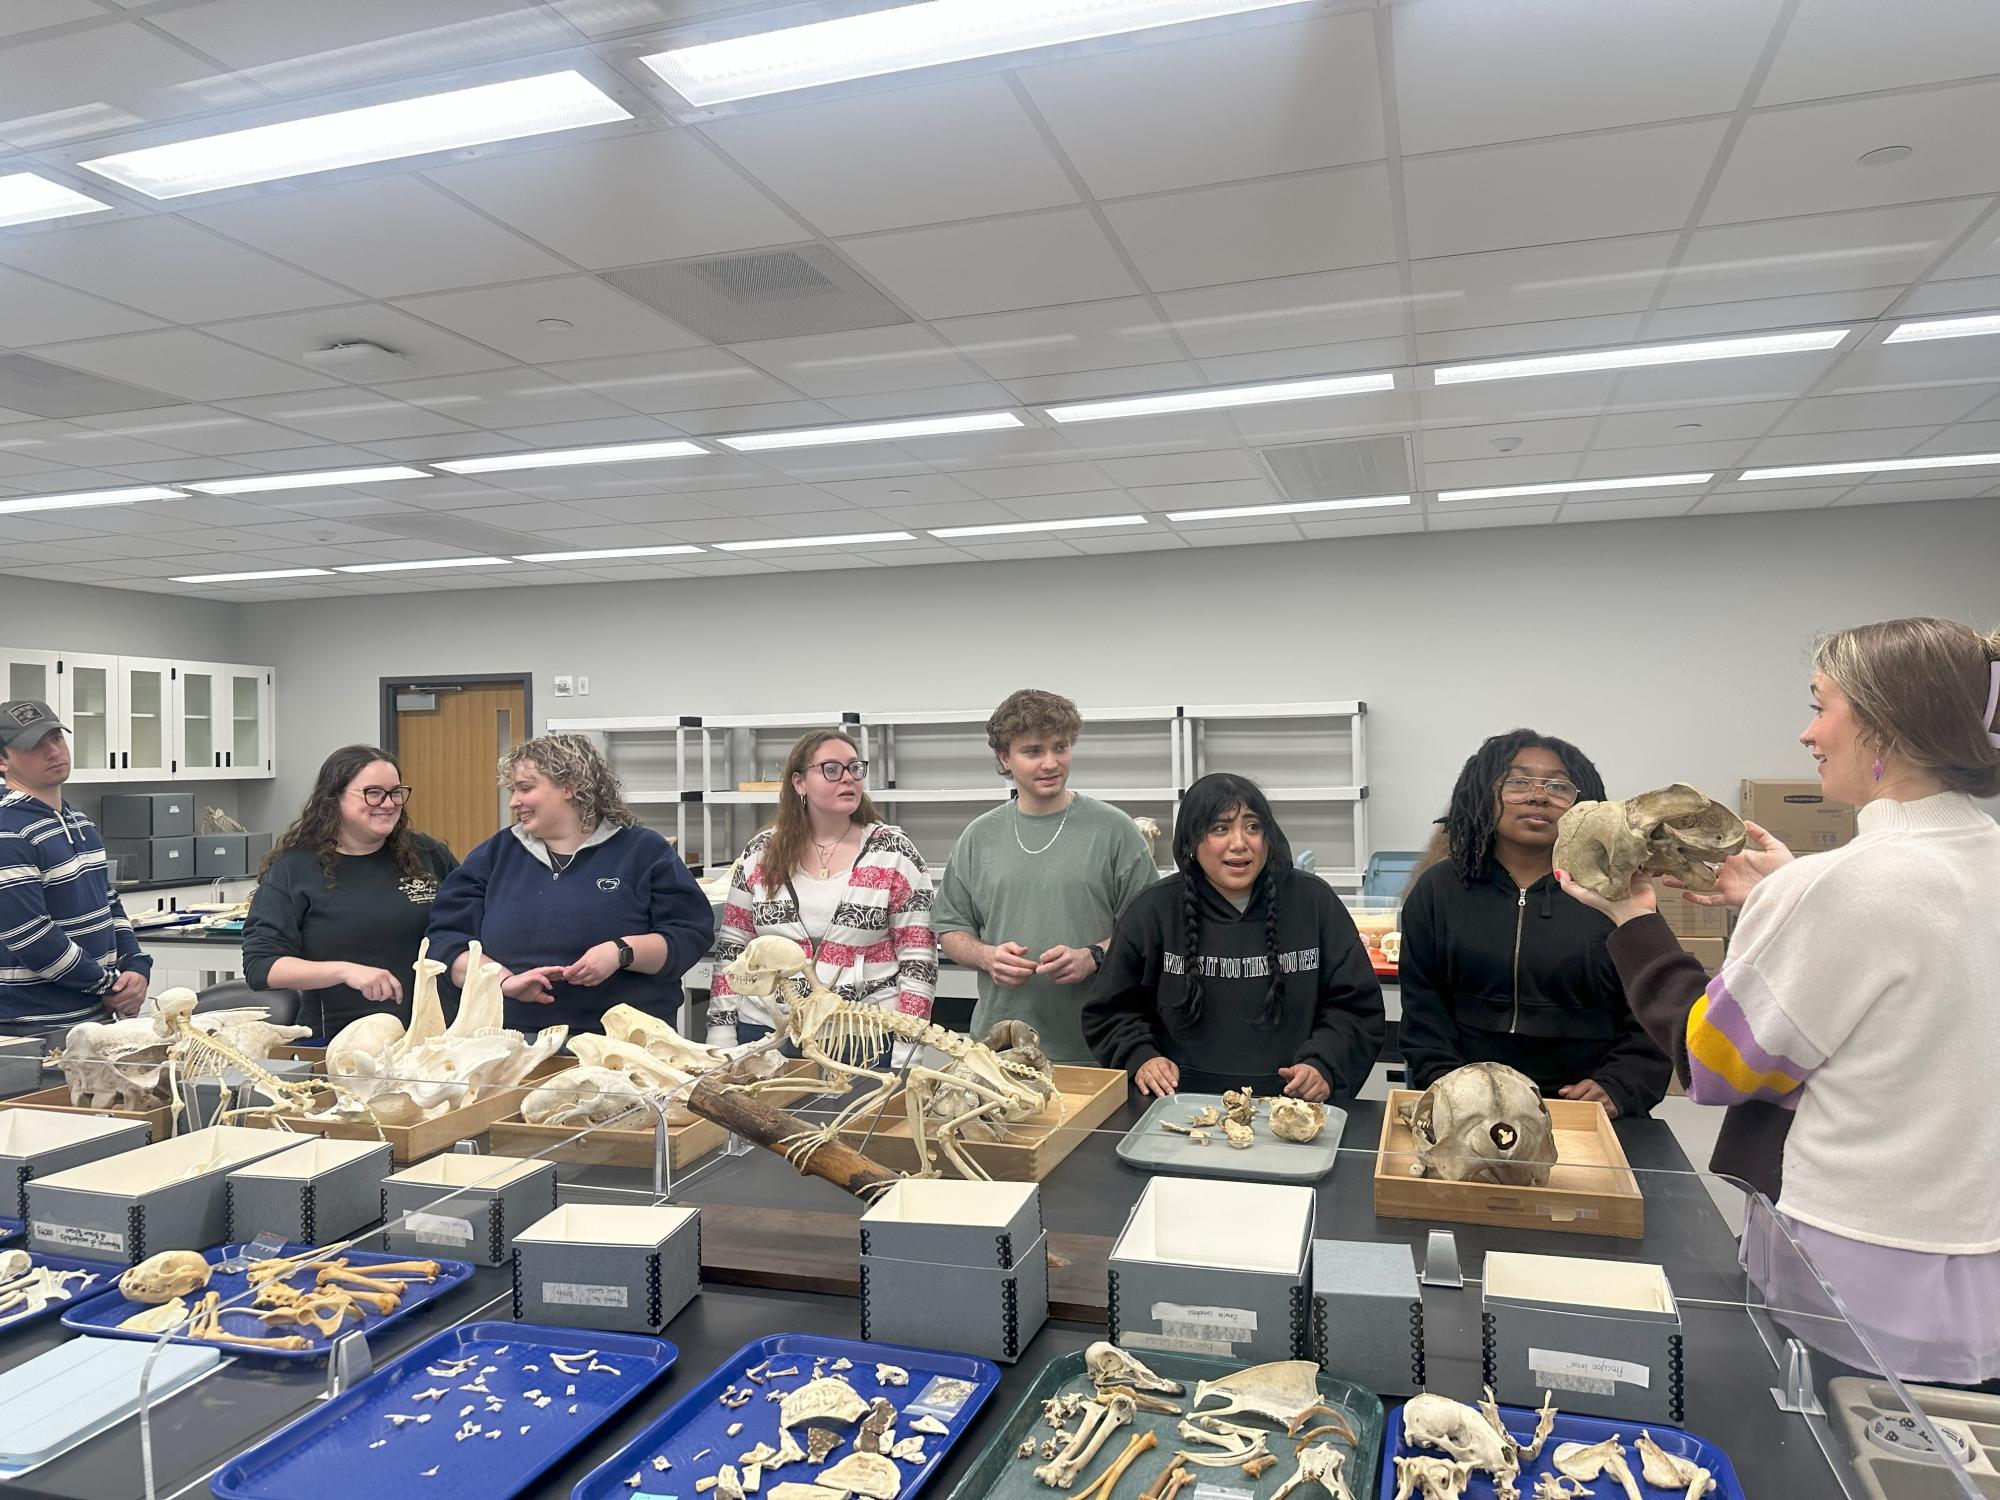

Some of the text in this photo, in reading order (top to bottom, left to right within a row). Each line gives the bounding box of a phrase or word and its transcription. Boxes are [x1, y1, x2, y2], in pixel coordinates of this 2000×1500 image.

[1163, 951, 1185, 975] WHA
[1205, 956, 1219, 977] IT
[1219, 957, 1241, 979] YOU
[1242, 955, 1270, 978] THIN
